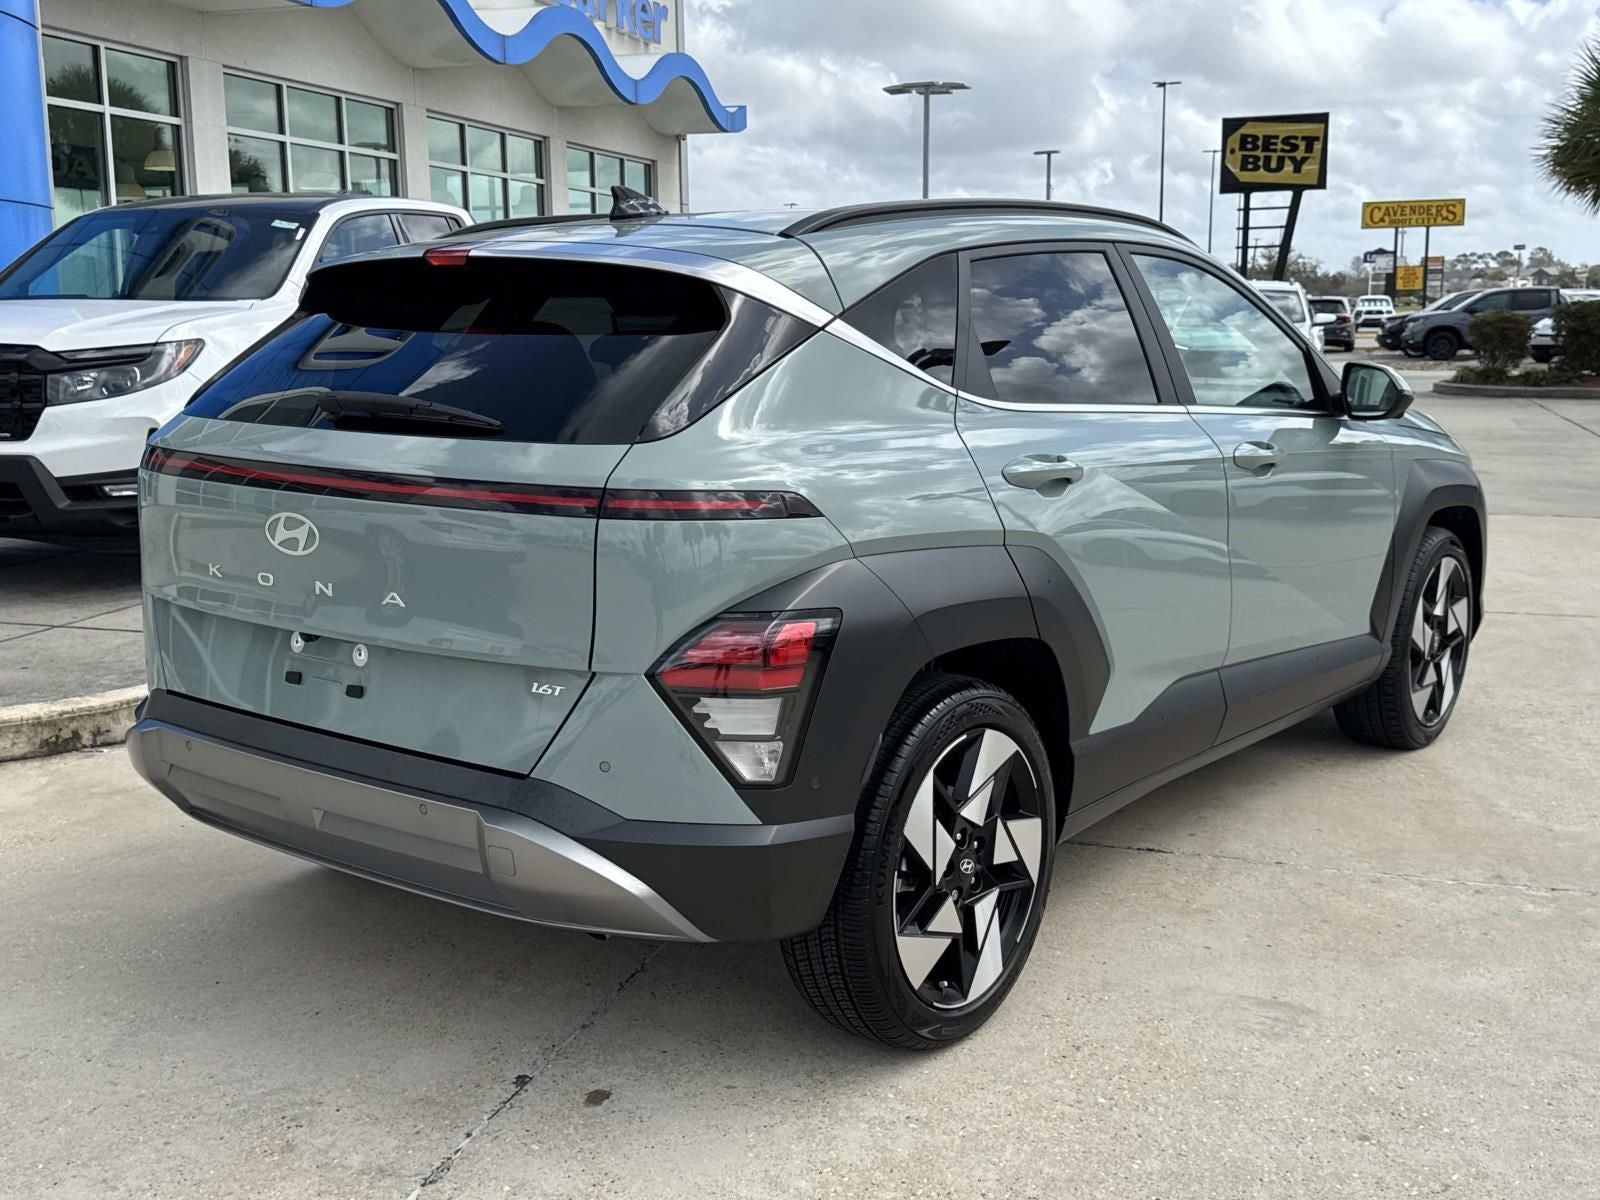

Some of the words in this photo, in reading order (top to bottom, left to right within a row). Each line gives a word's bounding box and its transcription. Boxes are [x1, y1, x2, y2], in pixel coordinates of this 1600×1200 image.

[1238, 133, 1320, 154] BEST
[1239, 154, 1312, 174] BUY
[1369, 202, 1457, 225] CAVENDER'S
[208, 562, 406, 607] KONA
